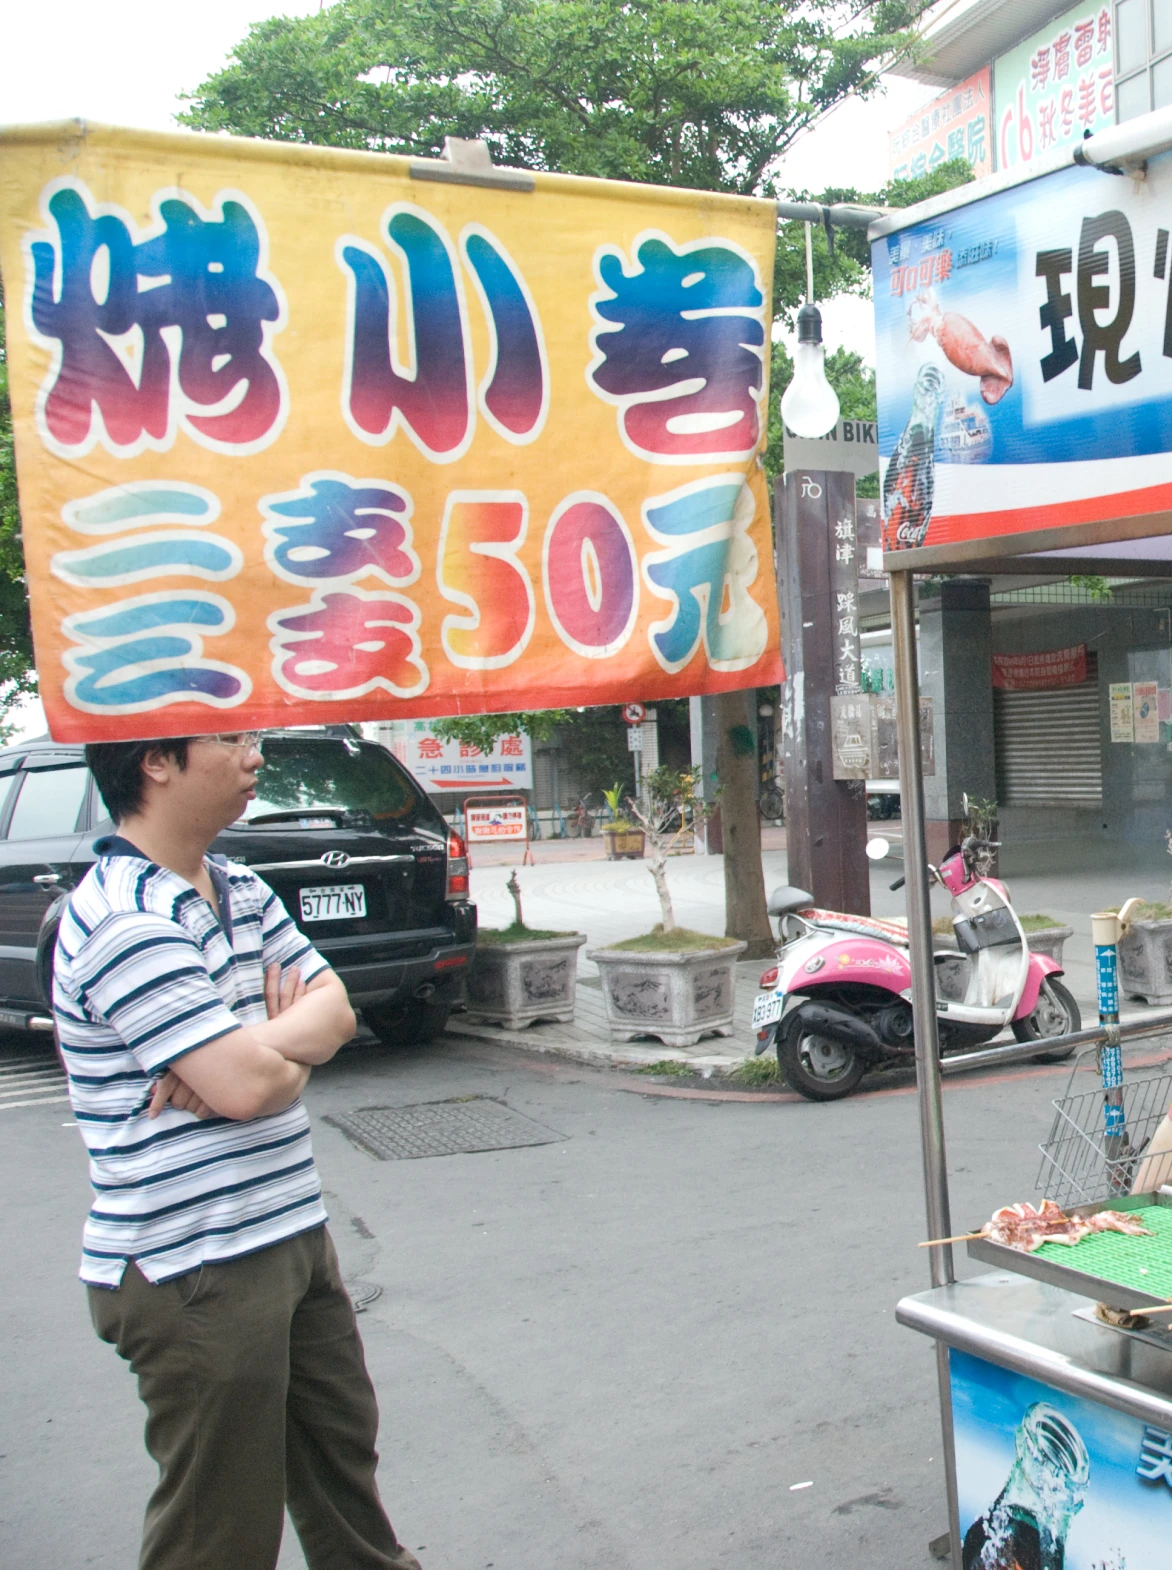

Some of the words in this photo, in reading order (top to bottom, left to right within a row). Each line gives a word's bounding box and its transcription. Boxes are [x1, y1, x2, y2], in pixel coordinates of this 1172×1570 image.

[843, 421, 879, 445] BIK
[834, 518, 856, 565] 旗津
[301, 892, 363, 917] 5777-NY
